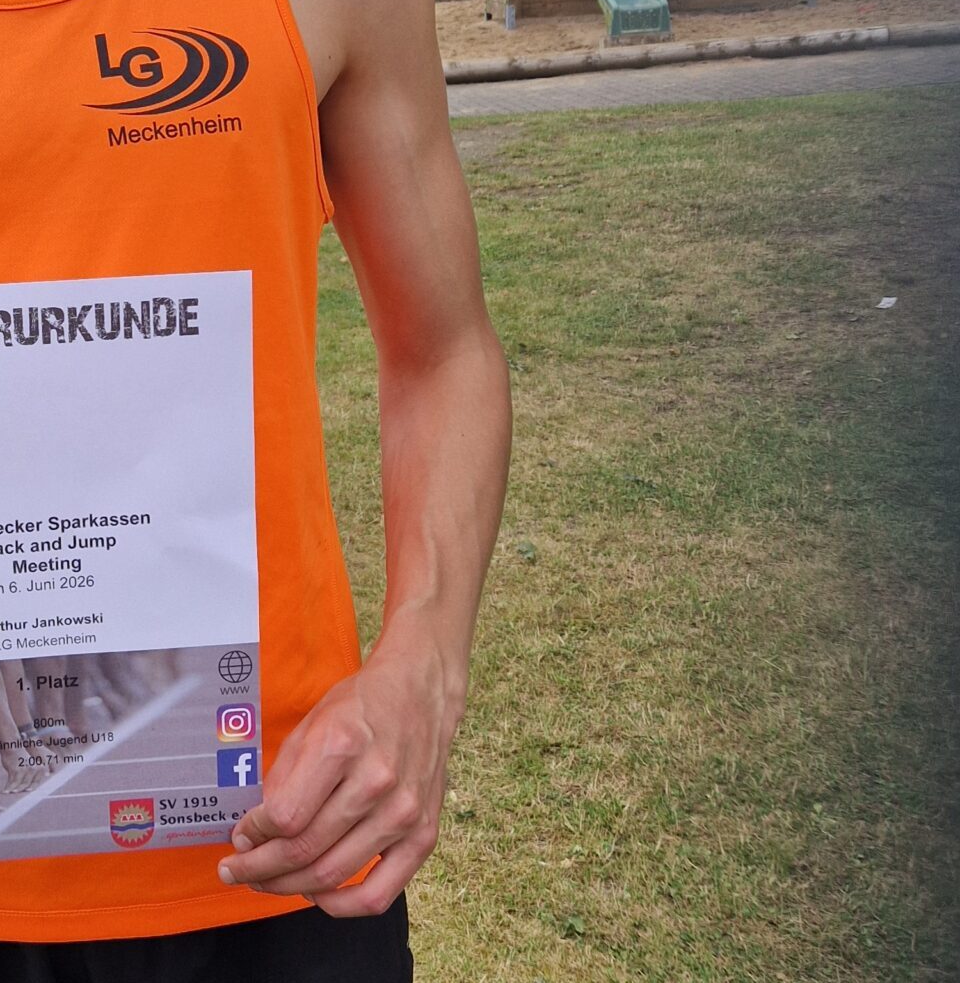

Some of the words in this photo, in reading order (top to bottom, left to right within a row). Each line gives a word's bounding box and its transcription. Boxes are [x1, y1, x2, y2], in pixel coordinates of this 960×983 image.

[93, 33, 163, 88] LG
[107, 114, 243, 147] Meckenheim
[48, 513, 151, 533] Sparkassen
[30, 537, 62, 553] and
[67, 535, 117, 551] Jump
[12, 557, 82, 574] Meeting
[8, 581, 22, 594] 6.
[26, 577, 55, 592] Juni
[60, 575, 95, 589] 2026
[31, 612, 104, 629] Jankowski
[16, 633, 97, 650] Meckenheim
[16, 677, 30, 691] 1.
[36, 674, 80, 690] Platz
[33, 717, 66, 729] 800m
[46, 733, 88, 748] Jugend
[91, 731, 114, 744] U18
[63, 753, 84, 765] min
[159, 798, 177, 811] SV
[183, 795, 219, 810] 1919
[159, 810, 227, 826] Sonsbeck
